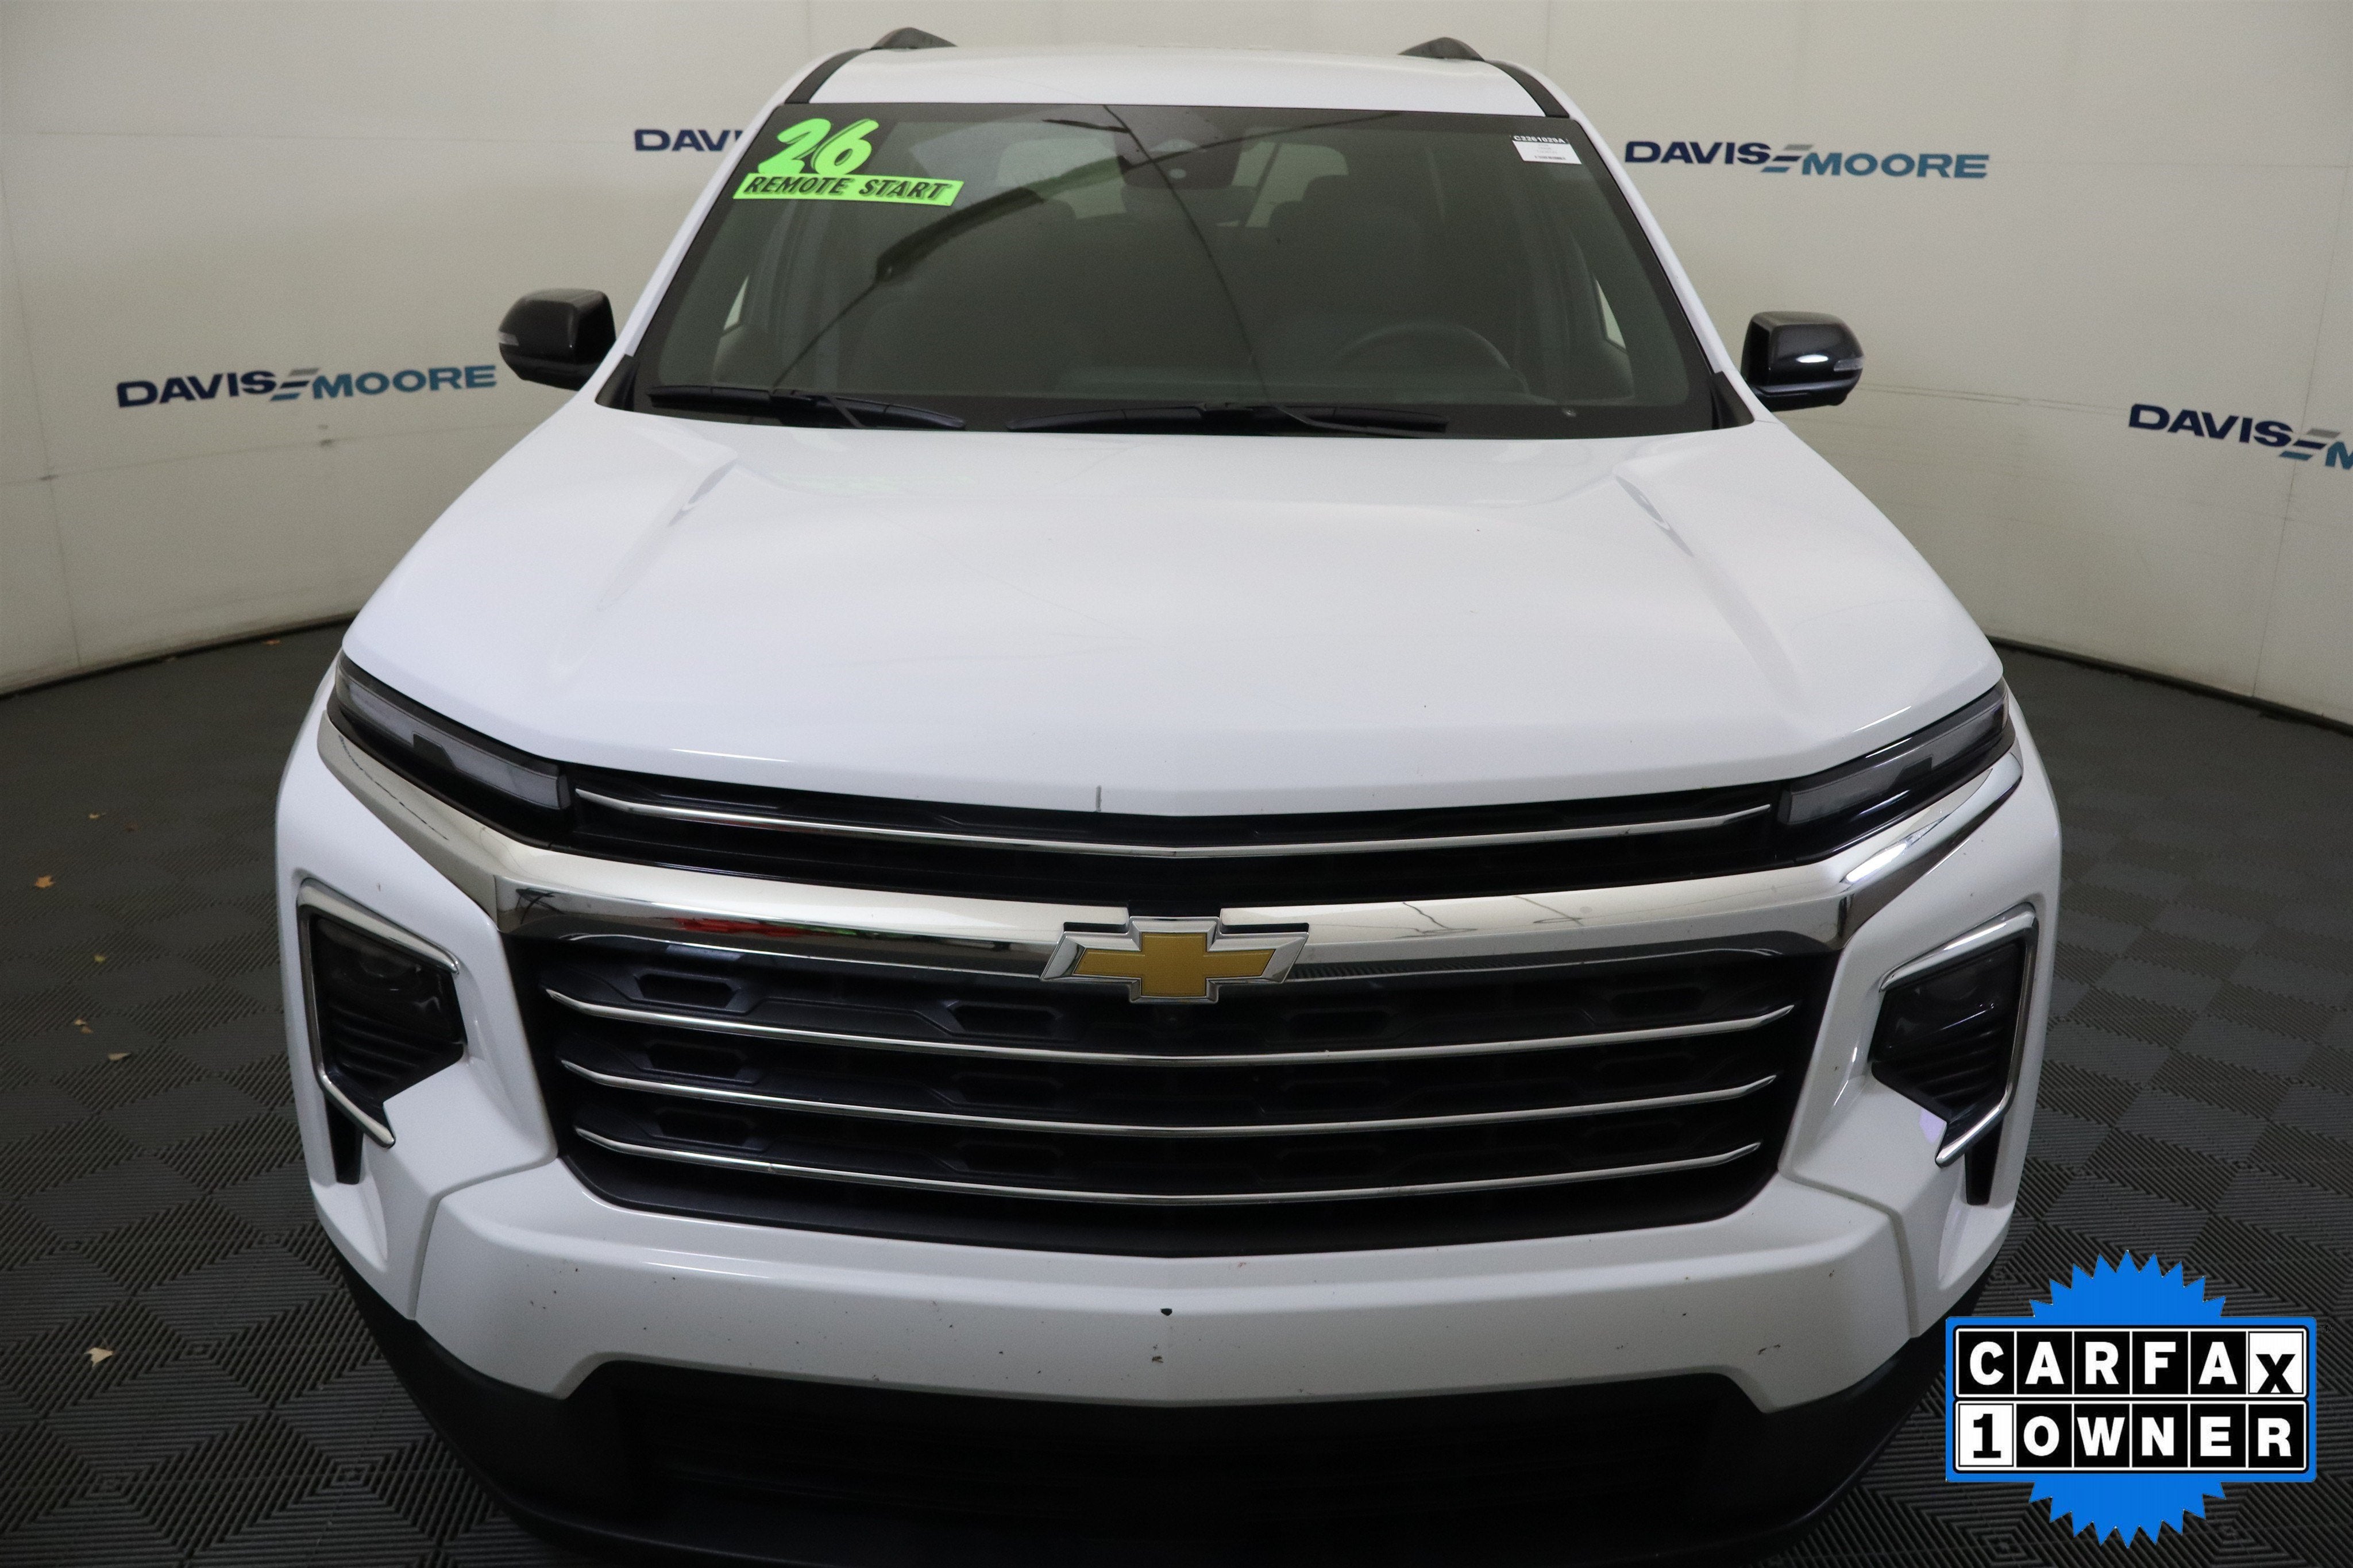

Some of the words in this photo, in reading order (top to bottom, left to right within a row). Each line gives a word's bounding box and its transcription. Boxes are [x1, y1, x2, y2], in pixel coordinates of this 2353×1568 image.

[758, 118, 880, 176] 26
[1625, 141, 1772, 165] DAVIS
[1801, 152, 1990, 179] MOORE
[743, 175, 854, 195] REMOTE
[859, 179, 953, 201] START
[115, 370, 277, 408] DAVIS
[312, 365, 497, 400] MOORE
[2128, 403, 2294, 447] DAVIS
